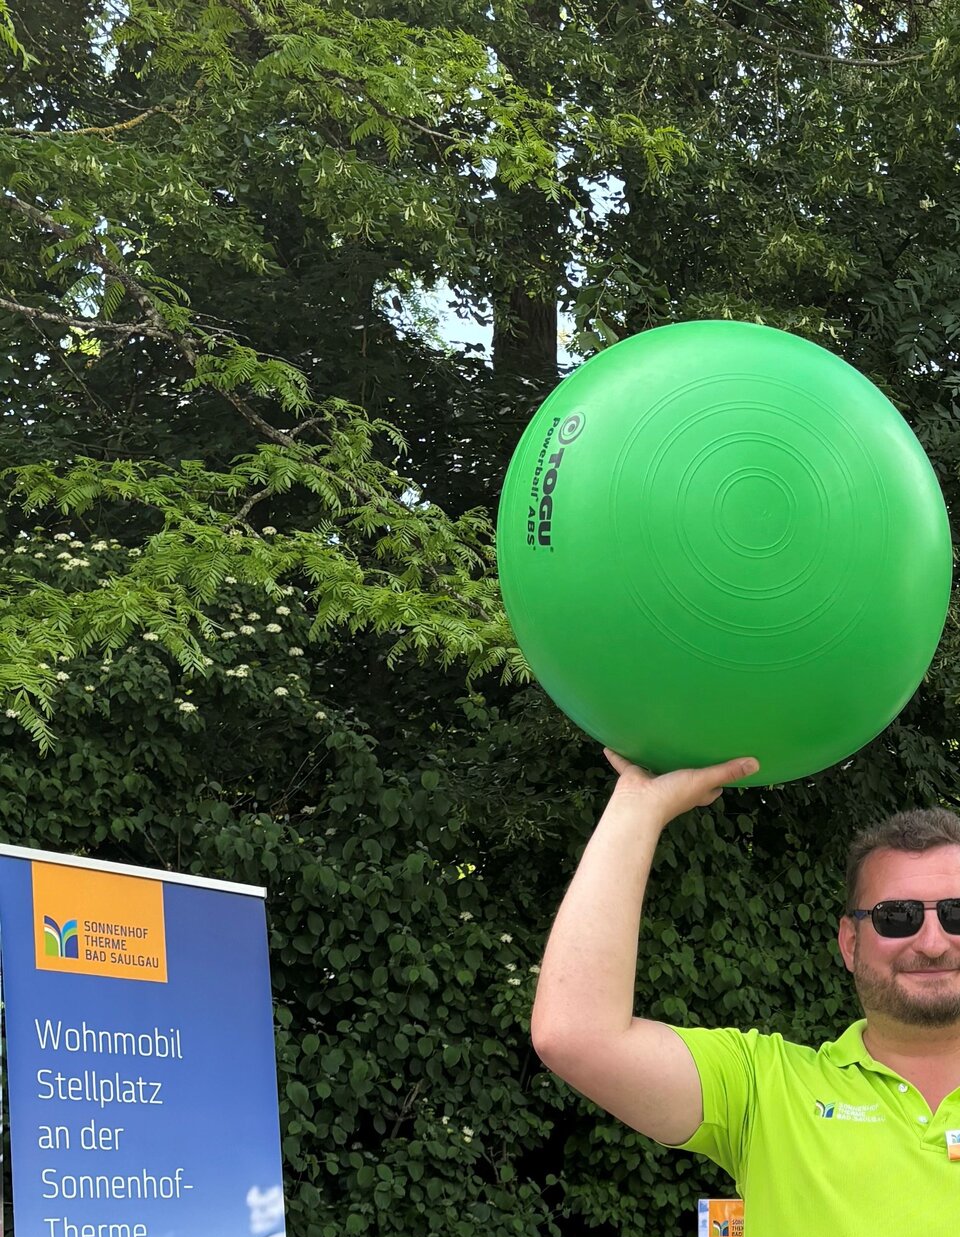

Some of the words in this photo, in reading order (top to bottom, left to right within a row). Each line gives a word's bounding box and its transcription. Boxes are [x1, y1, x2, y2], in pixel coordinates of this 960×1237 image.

[538, 447, 565, 546] TOGU
[526, 505, 536, 546] ABS
[84, 920, 149, 939] SONNENHOF
[84, 935, 127, 951] THERME
[85, 949, 106, 962] BAD
[111, 952, 159, 968] SAULGAU
[35, 1018, 183, 1059] Wohnmobil
[37, 1069, 163, 1108] Stellplatz
[38, 1124, 70, 1150] an
[80, 1119, 124, 1151] der
[42, 1167, 194, 1199] Sonnenhof-
